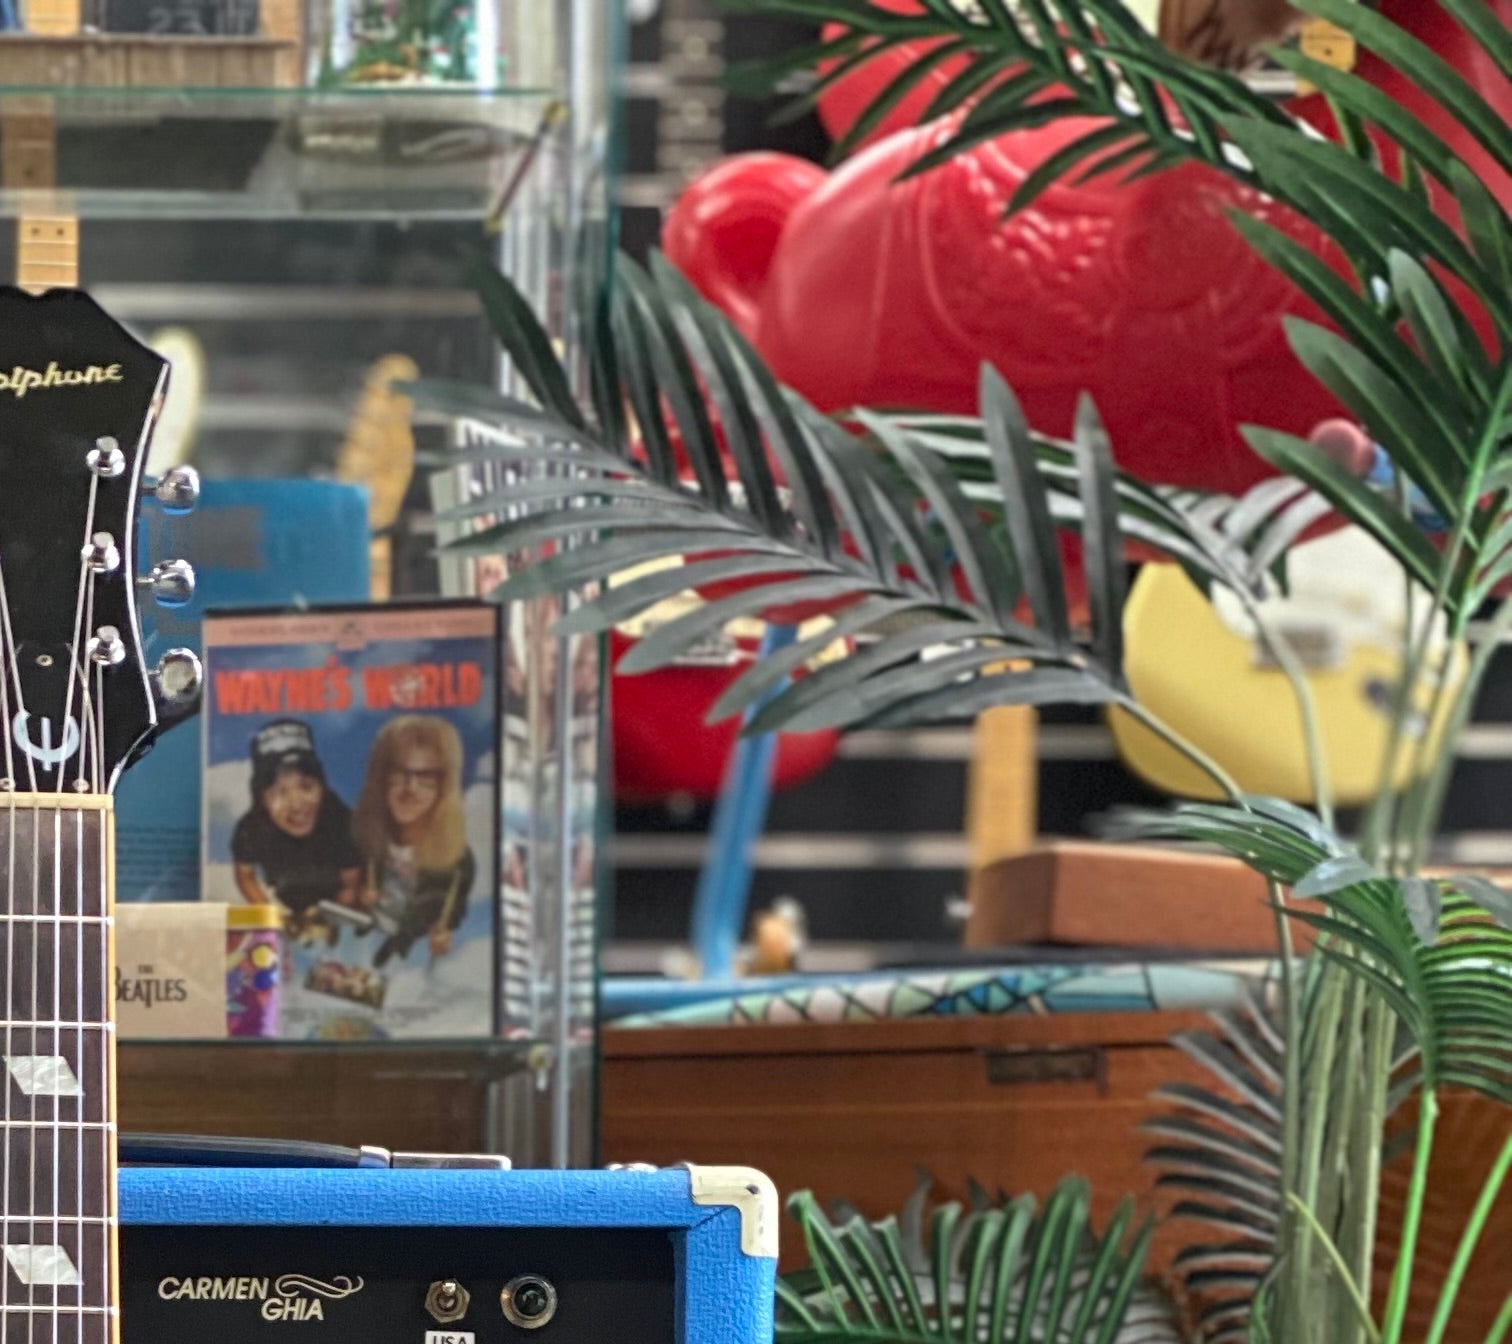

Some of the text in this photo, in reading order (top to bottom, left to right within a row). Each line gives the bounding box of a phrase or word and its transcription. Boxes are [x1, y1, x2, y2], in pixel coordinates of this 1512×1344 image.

[215, 653, 483, 715] WAYNE'S WORLD
[158, 1276, 269, 1300] CARMEN
[261, 1297, 324, 1321] GHIA
